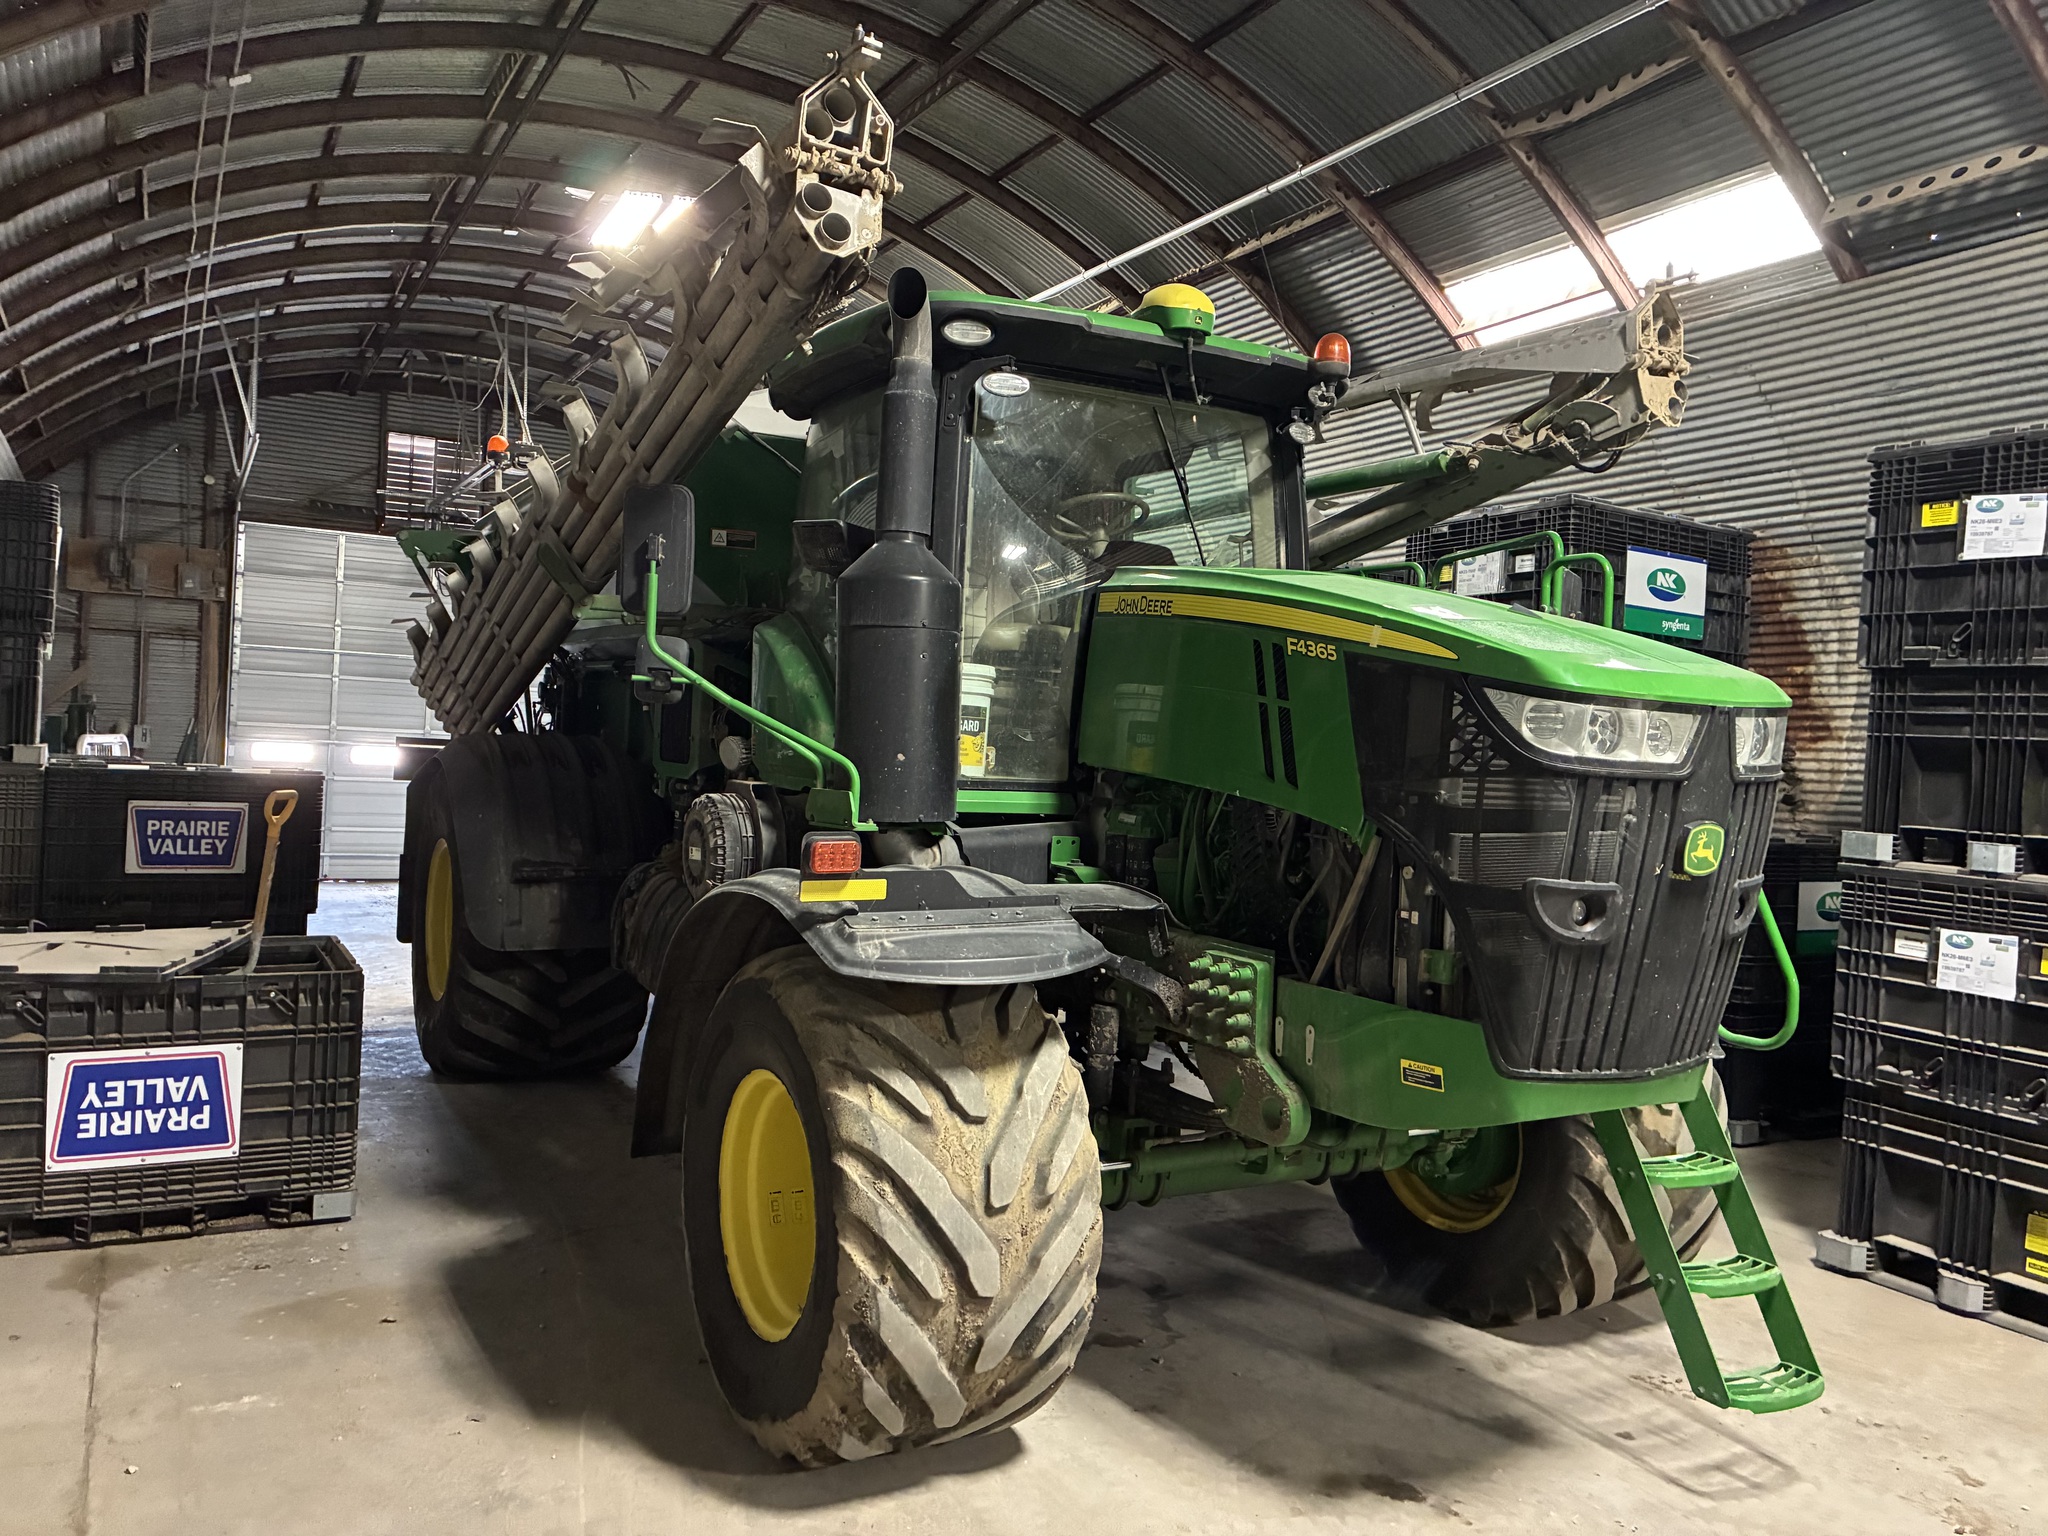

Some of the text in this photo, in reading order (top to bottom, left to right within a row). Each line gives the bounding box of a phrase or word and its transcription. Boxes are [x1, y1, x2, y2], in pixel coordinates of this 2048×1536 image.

[1982, 499, 1998, 508] NK
[1656, 571, 1678, 589] NK
[1662, 619, 1690, 632] syngenta
[1286, 637, 1337, 661] F4365
[147, 820, 230, 837] PRAIRIE
[147, 838, 228, 855] VALLEY
[1952, 934, 1968, 945] NK
[1413, 1063, 1436, 1073] CAUTION
[79, 1075, 210, 1109] VALLEY
[76, 1104, 211, 1139] PRAIRIE
